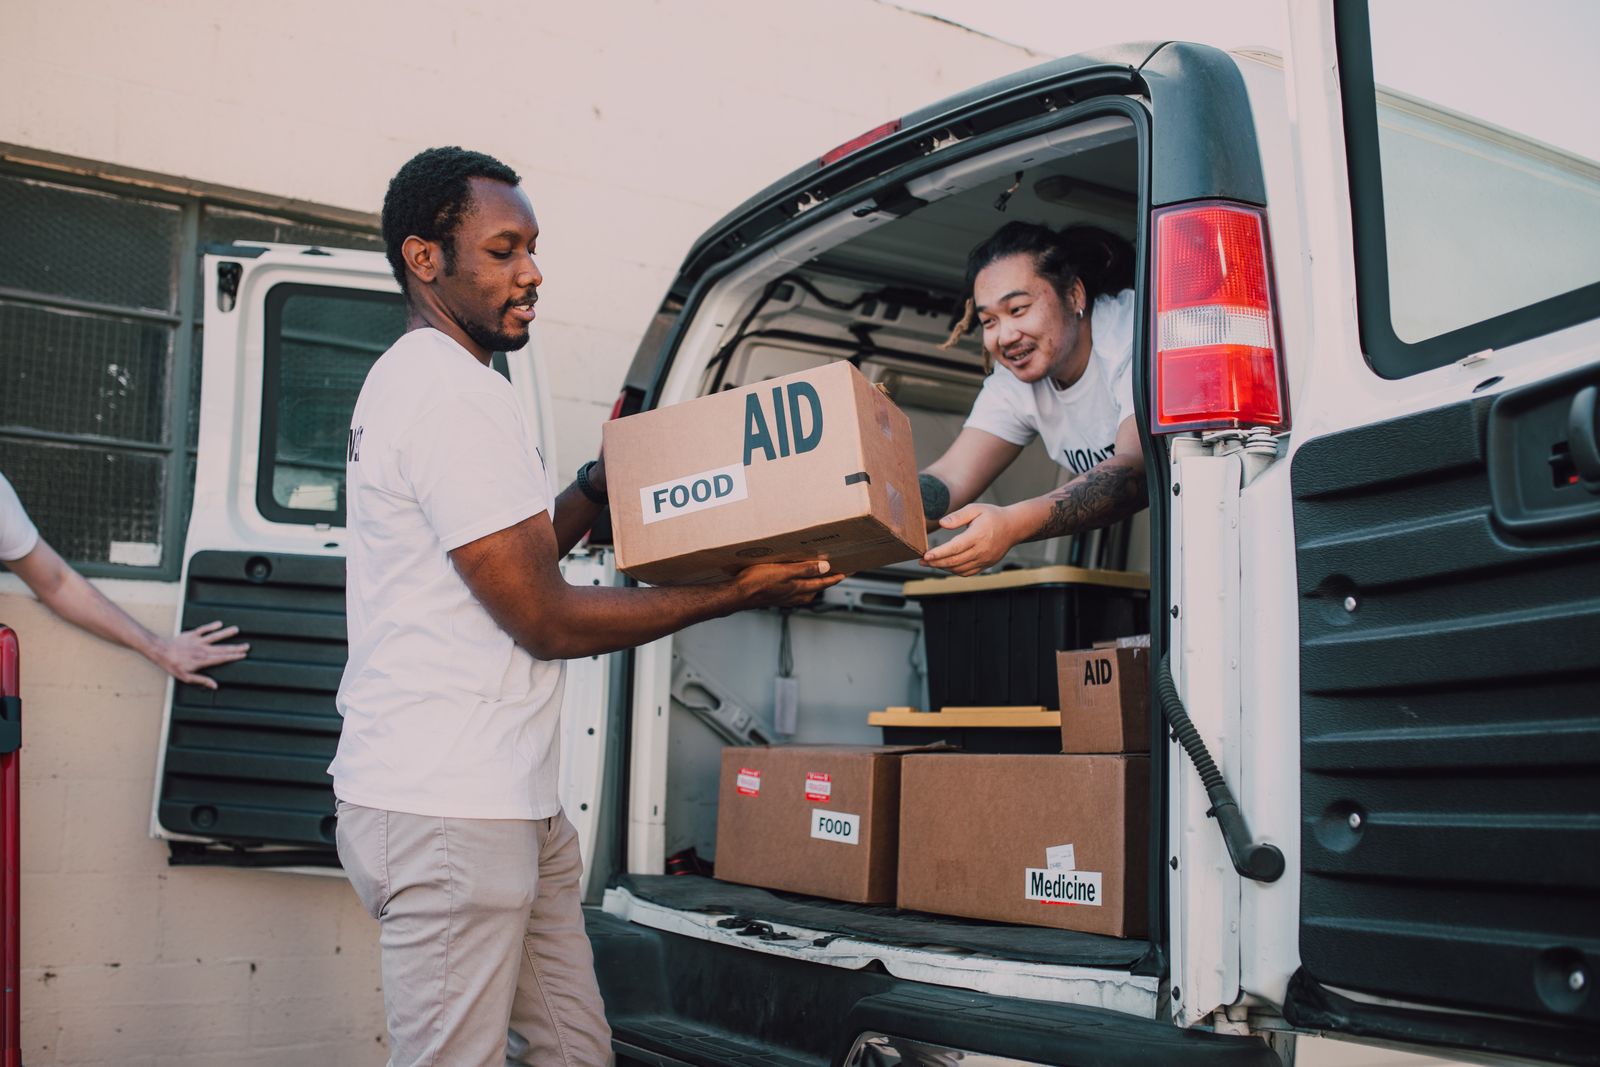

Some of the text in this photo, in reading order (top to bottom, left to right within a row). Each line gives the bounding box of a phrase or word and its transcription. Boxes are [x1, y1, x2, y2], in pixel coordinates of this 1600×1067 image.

[743, 381, 823, 466] AID
[653, 474, 734, 513] FOOD
[1084, 658, 1113, 686] AID
[819, 816, 852, 837] FOOD
[1031, 871, 1096, 902] Medicine
